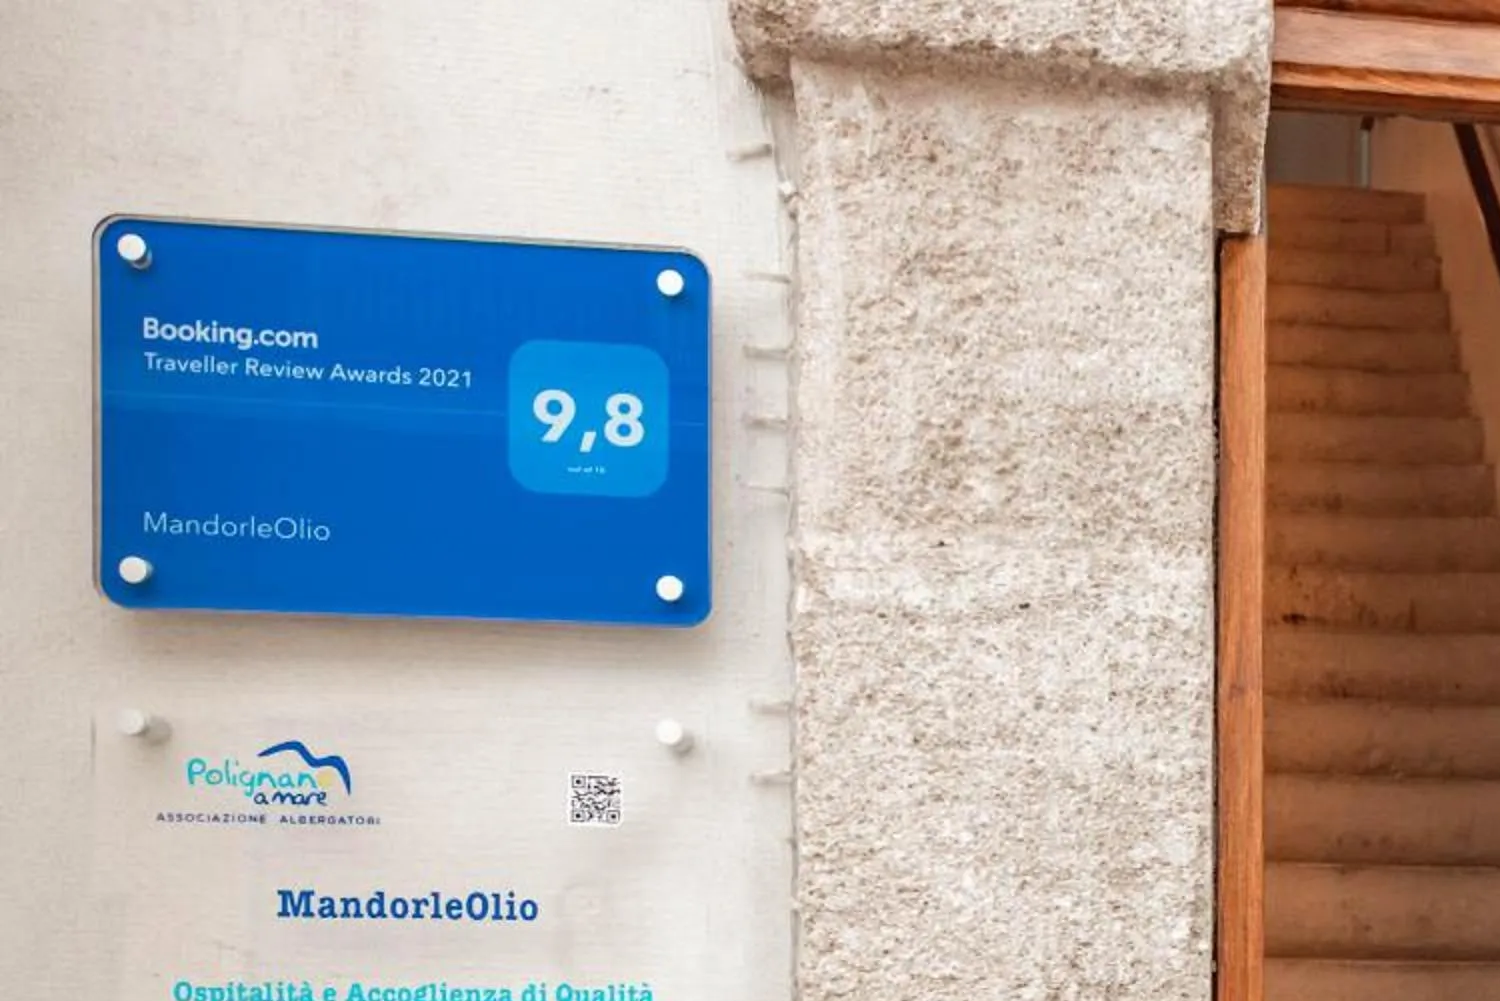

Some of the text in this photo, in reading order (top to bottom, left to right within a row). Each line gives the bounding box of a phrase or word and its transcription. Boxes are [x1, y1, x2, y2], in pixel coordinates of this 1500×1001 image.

[143, 316, 318, 350] Booking.com
[144, 352, 472, 388] Traveller Review Awards 2021
[532, 389, 645, 452] 9,8
[143, 511, 330, 541] MandorleOlio
[272, 791, 327, 806] mare
[156, 812, 381, 825] ASSOCIAZIONE ALBERGATORI
[277, 889, 539, 922] MandorleOlio
